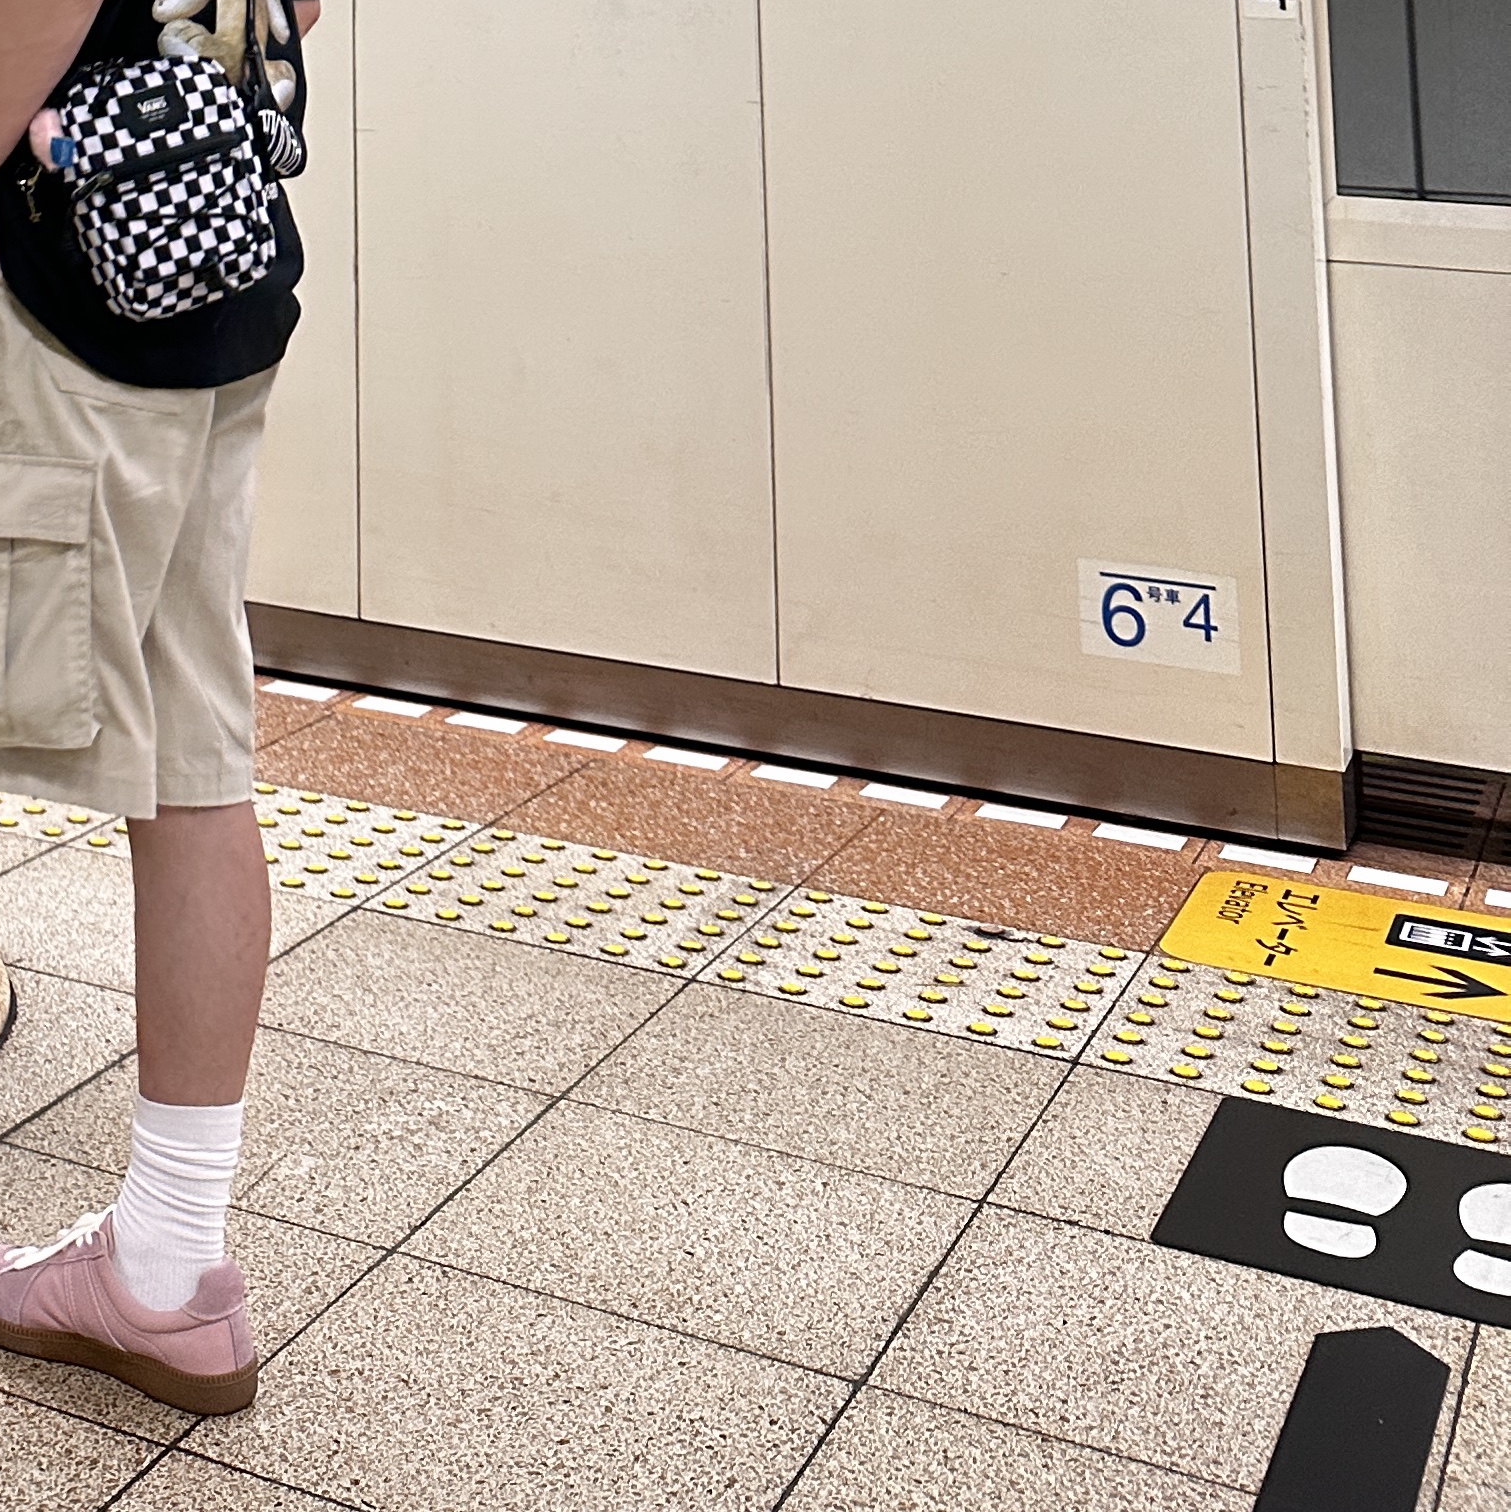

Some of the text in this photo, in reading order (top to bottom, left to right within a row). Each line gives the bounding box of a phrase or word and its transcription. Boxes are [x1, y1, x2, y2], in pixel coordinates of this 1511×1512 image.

[1101, 582, 1218, 647] 6 号車 4
[1217, 879, 1268, 925] Elevator
[1255, 888, 1320, 967] エレベーター
